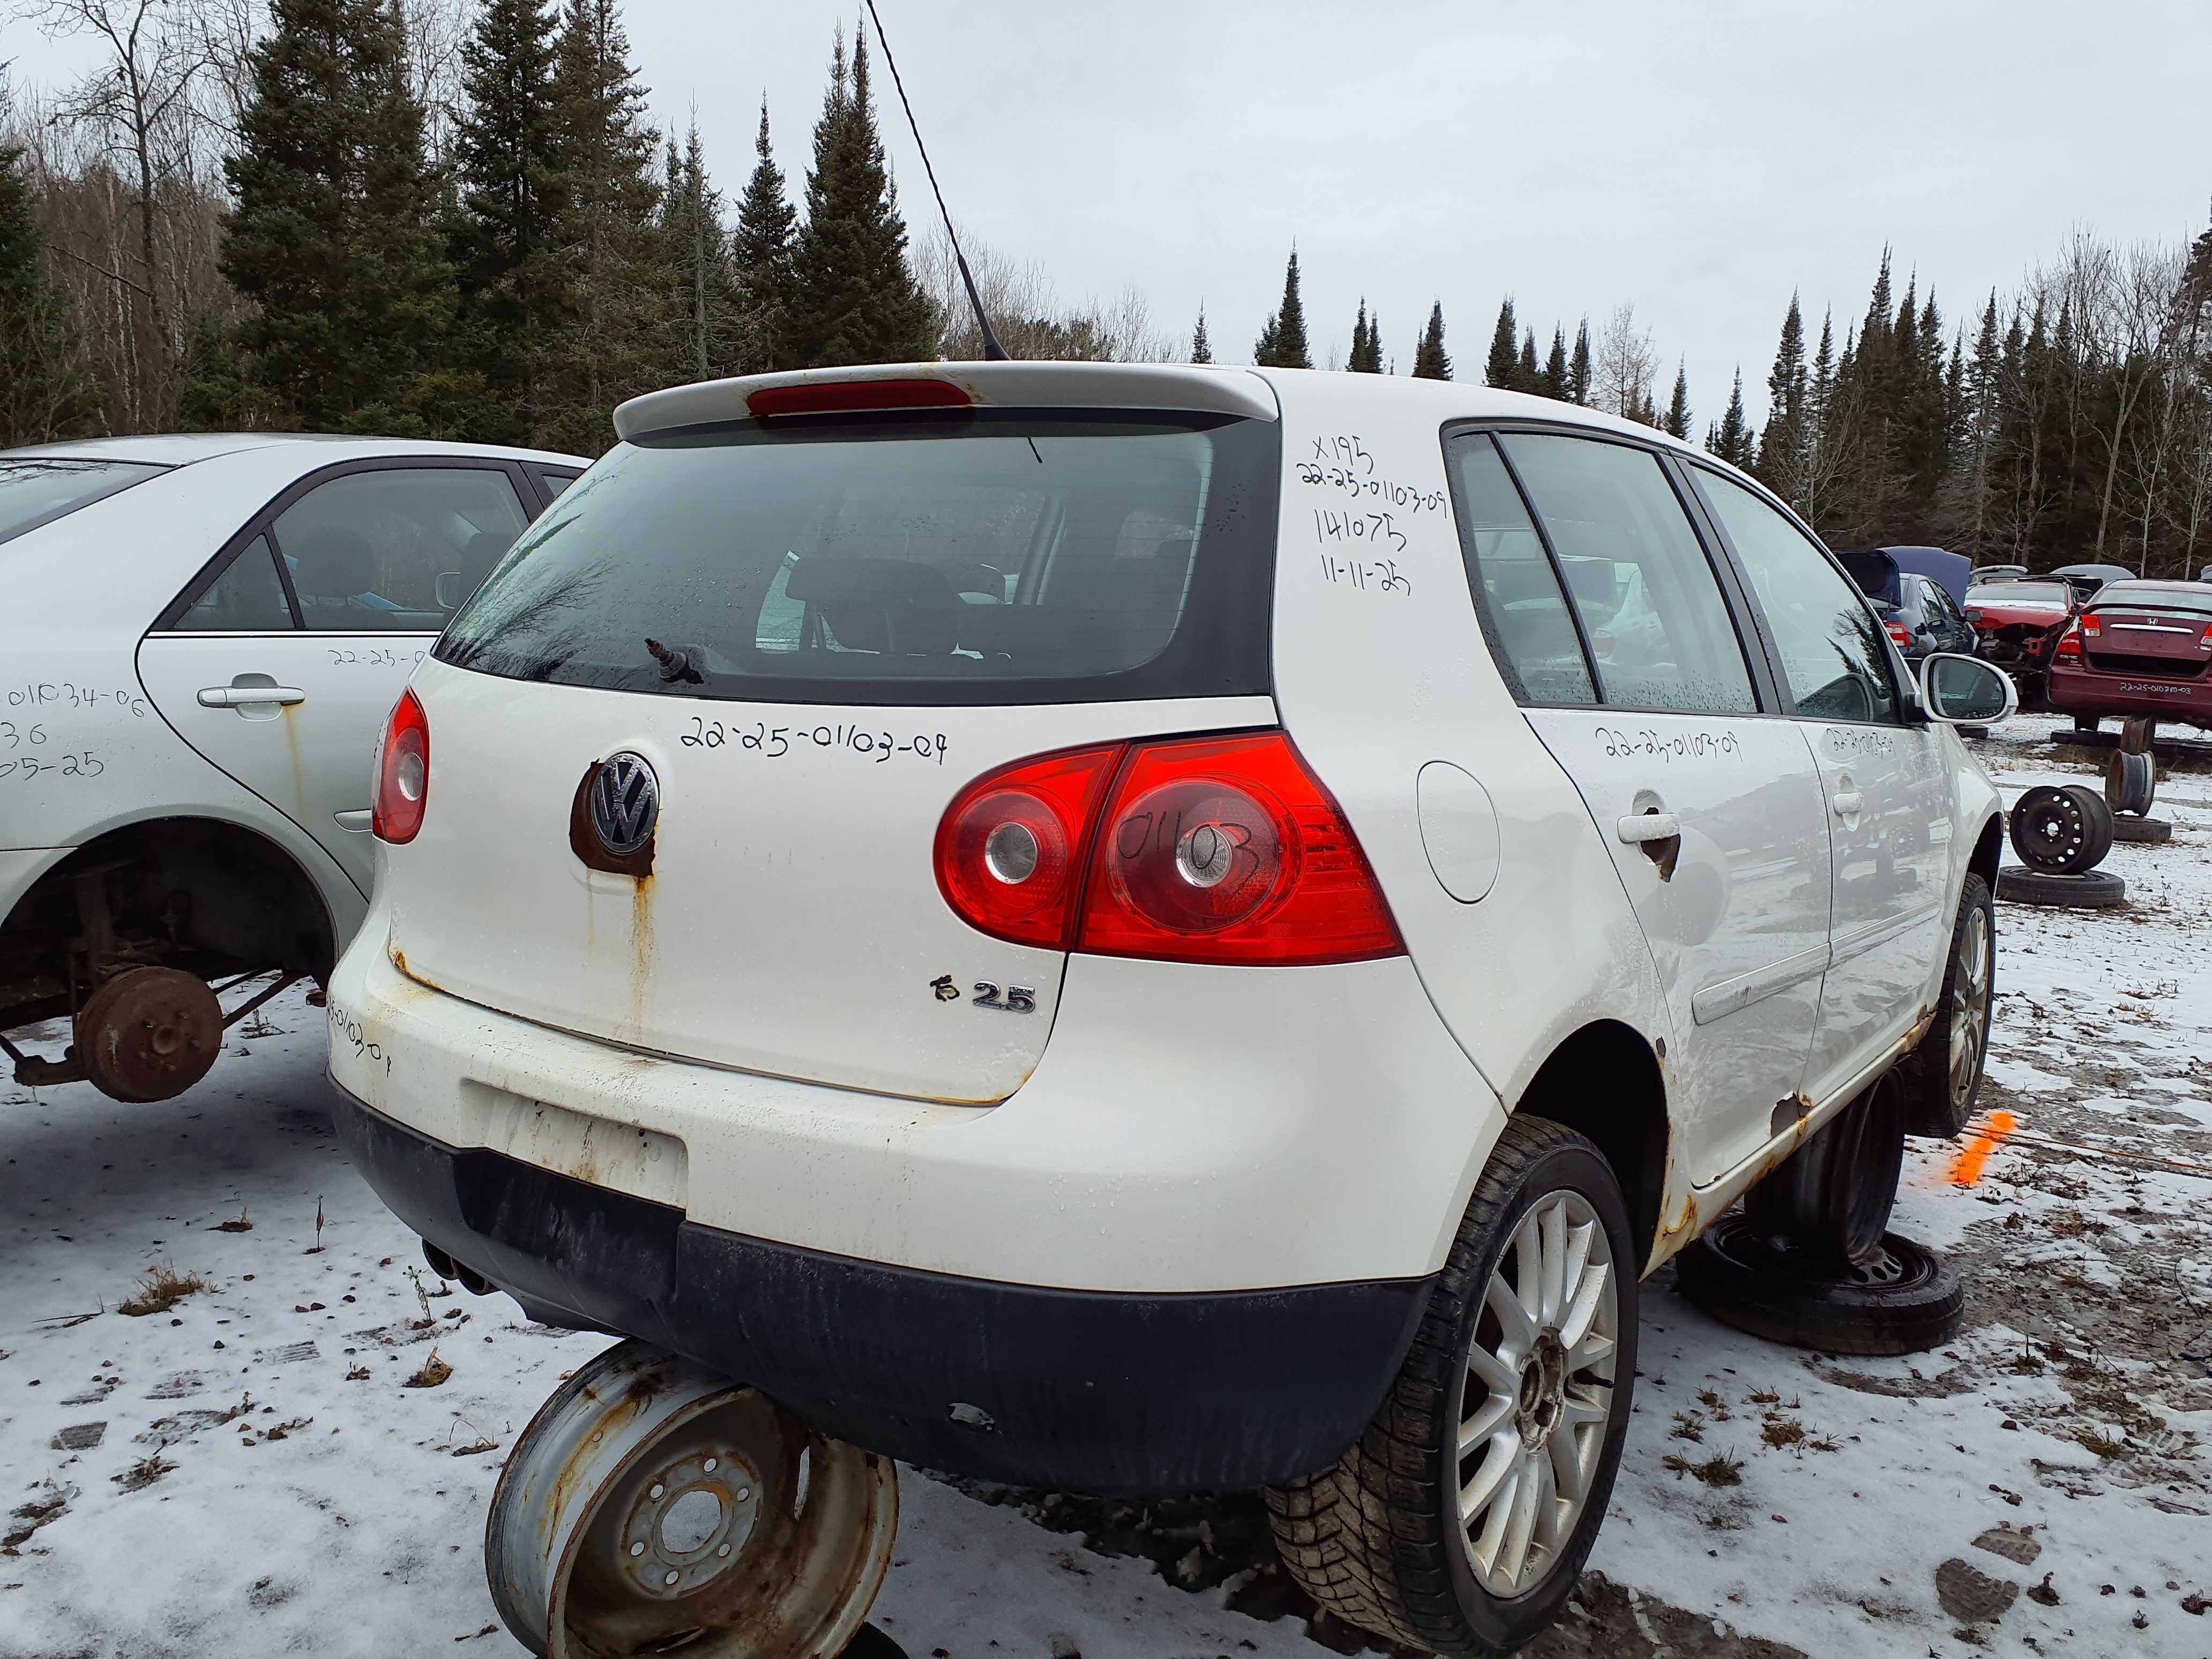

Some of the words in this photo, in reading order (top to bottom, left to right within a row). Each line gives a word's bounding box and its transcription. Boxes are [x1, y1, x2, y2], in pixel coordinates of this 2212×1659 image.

[1313, 436, 1373, 474] X195
[1296, 463, 1447, 519] 22-25-01103-09
[1314, 509, 1406, 551] 141075
[1321, 554, 1410, 596] 11-11-25
[681, 716, 947, 765] 22-25-01103-09
[1595, 727, 1743, 763] 22-25-01103-09
[1117, 811, 1260, 899] 01103
